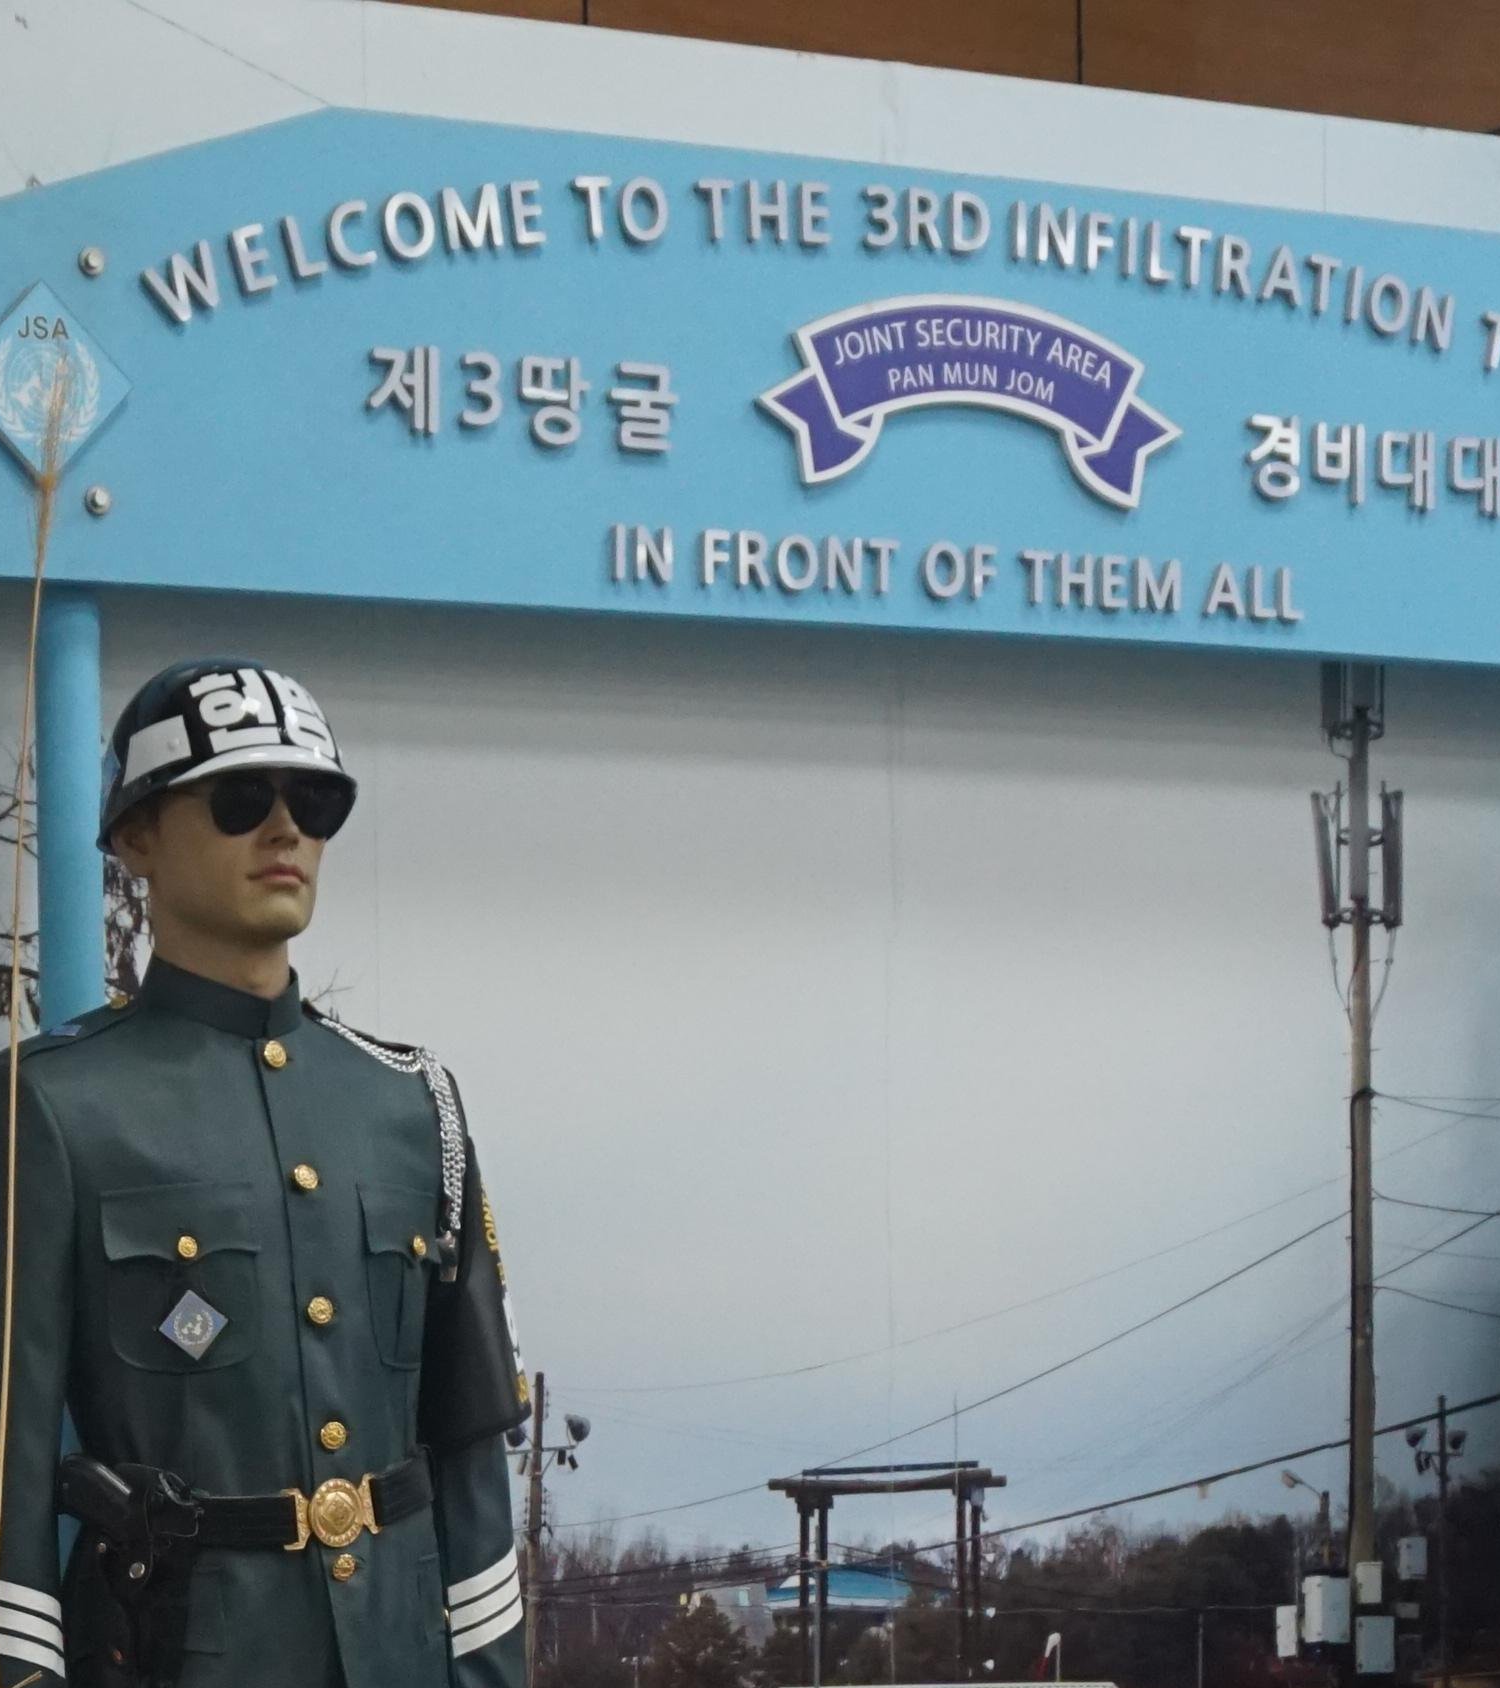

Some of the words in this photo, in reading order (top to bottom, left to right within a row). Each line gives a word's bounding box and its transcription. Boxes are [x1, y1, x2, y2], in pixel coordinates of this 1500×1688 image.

[140, 179, 547, 322] WELCOME
[572, 175, 670, 243] TO
[696, 178, 832, 247] THE
[864, 184, 991, 252] 3RD
[1008, 199, 1456, 352] INFILTRATION
[17, 314, 70, 340] JSA
[833, 320, 907, 366] JOINT
[914, 317, 1042, 357] SECURITY
[1046, 336, 1113, 390] AREA
[367, 345, 680, 453] 제3땅굴
[887, 363, 935, 392] PAN
[943, 361, 998, 389] MUN
[1005, 368, 1056, 403] JOM
[611, 522, 673, 584] IN
[700, 527, 899, 594] FRONT
[922, 539, 998, 600] OF
[1019, 549, 1182, 612] THEM
[1201, 561, 1305, 621] ALL
